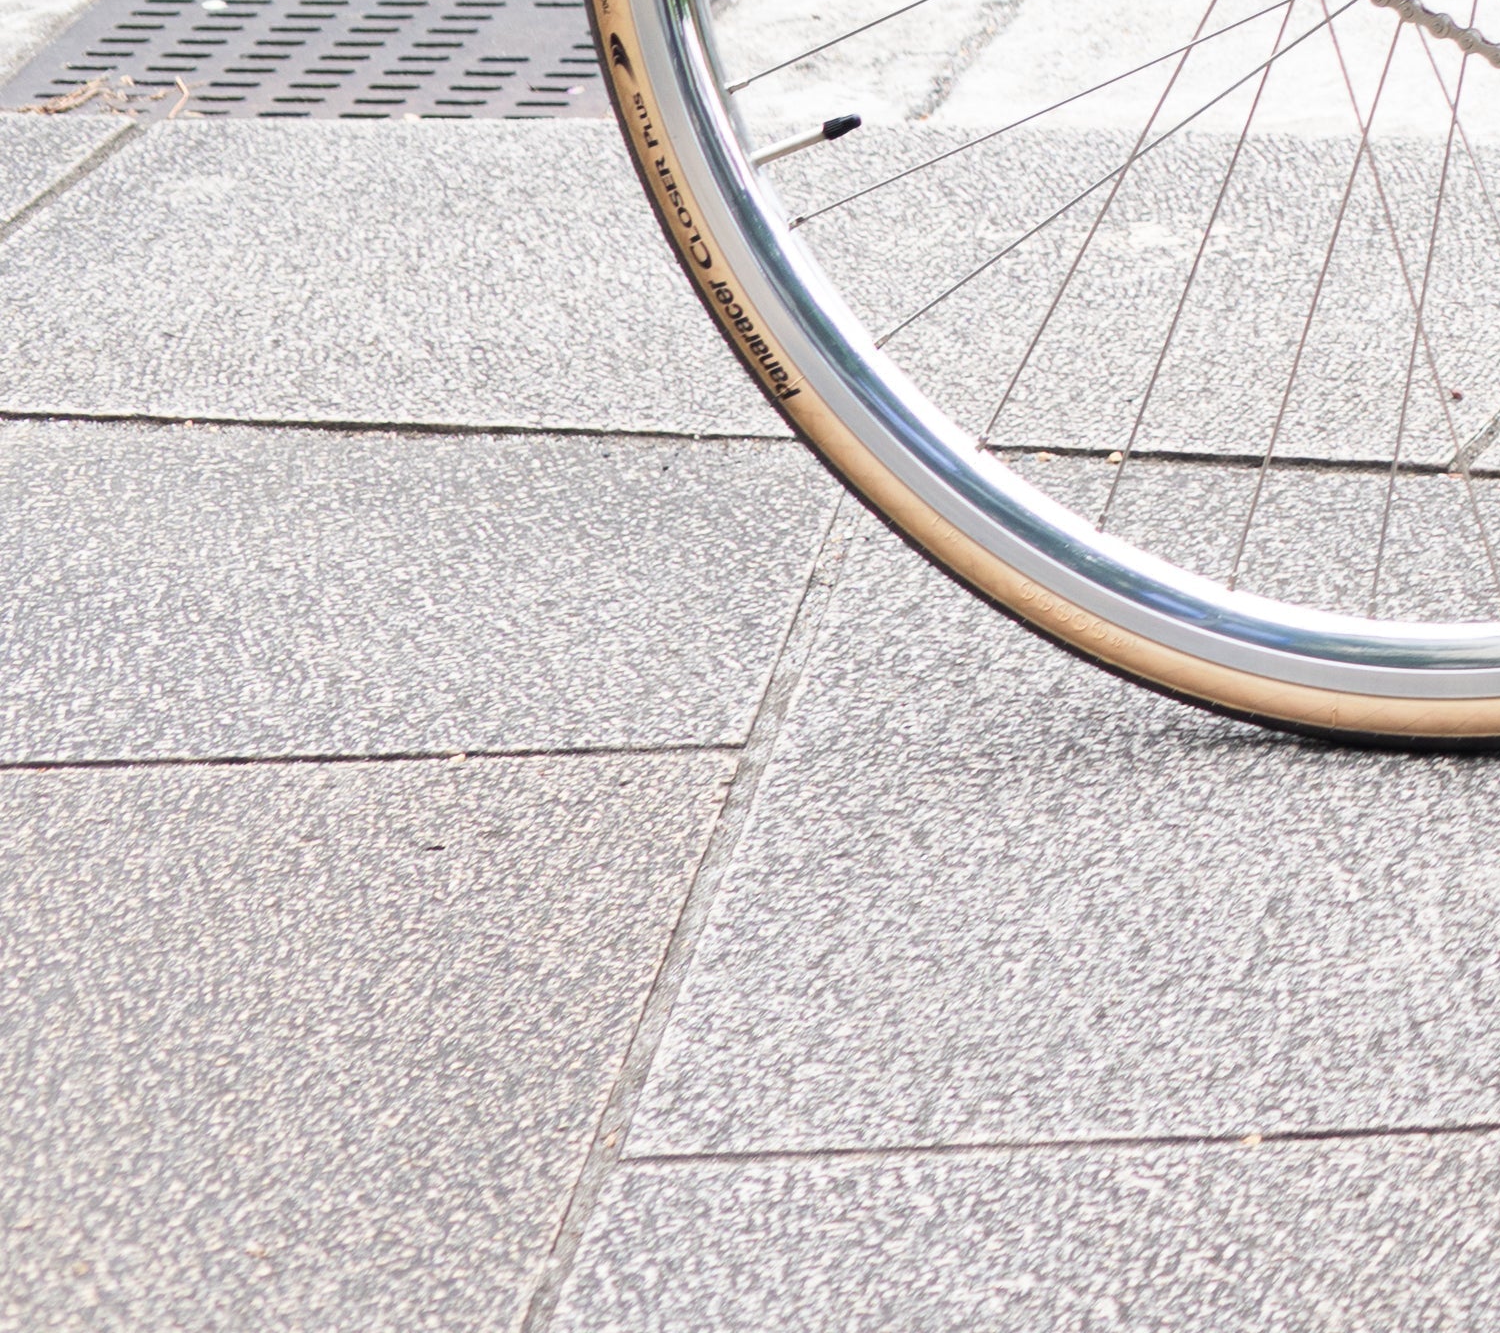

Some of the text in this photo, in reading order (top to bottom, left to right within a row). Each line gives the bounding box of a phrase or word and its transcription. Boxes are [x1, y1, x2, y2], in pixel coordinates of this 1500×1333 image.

[632, 91, 800, 402] Panaracer CLOSER PLUS
